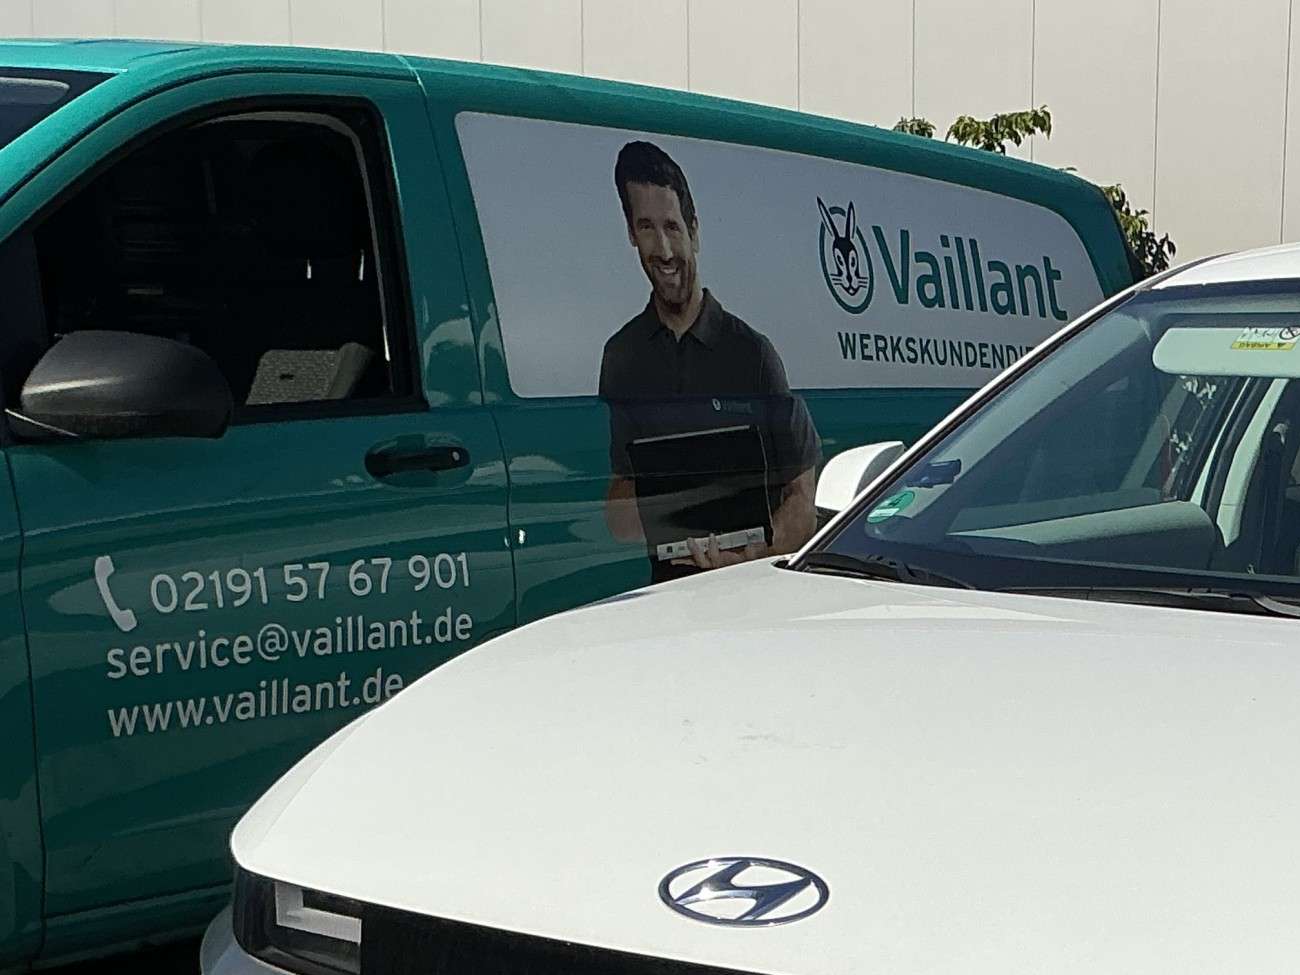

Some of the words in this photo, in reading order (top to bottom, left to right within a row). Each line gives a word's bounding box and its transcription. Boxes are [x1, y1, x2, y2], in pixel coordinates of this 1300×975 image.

[872, 225, 1068, 321] Vaillant
[151, 566, 268, 613] 02191
[283, 561, 330, 602] 57
[349, 557, 392, 597] 67
[407, 552, 470, 592] 901
[107, 607, 473, 679] service@vaillant.de
[107, 667, 404, 737] www.vaillant.de
